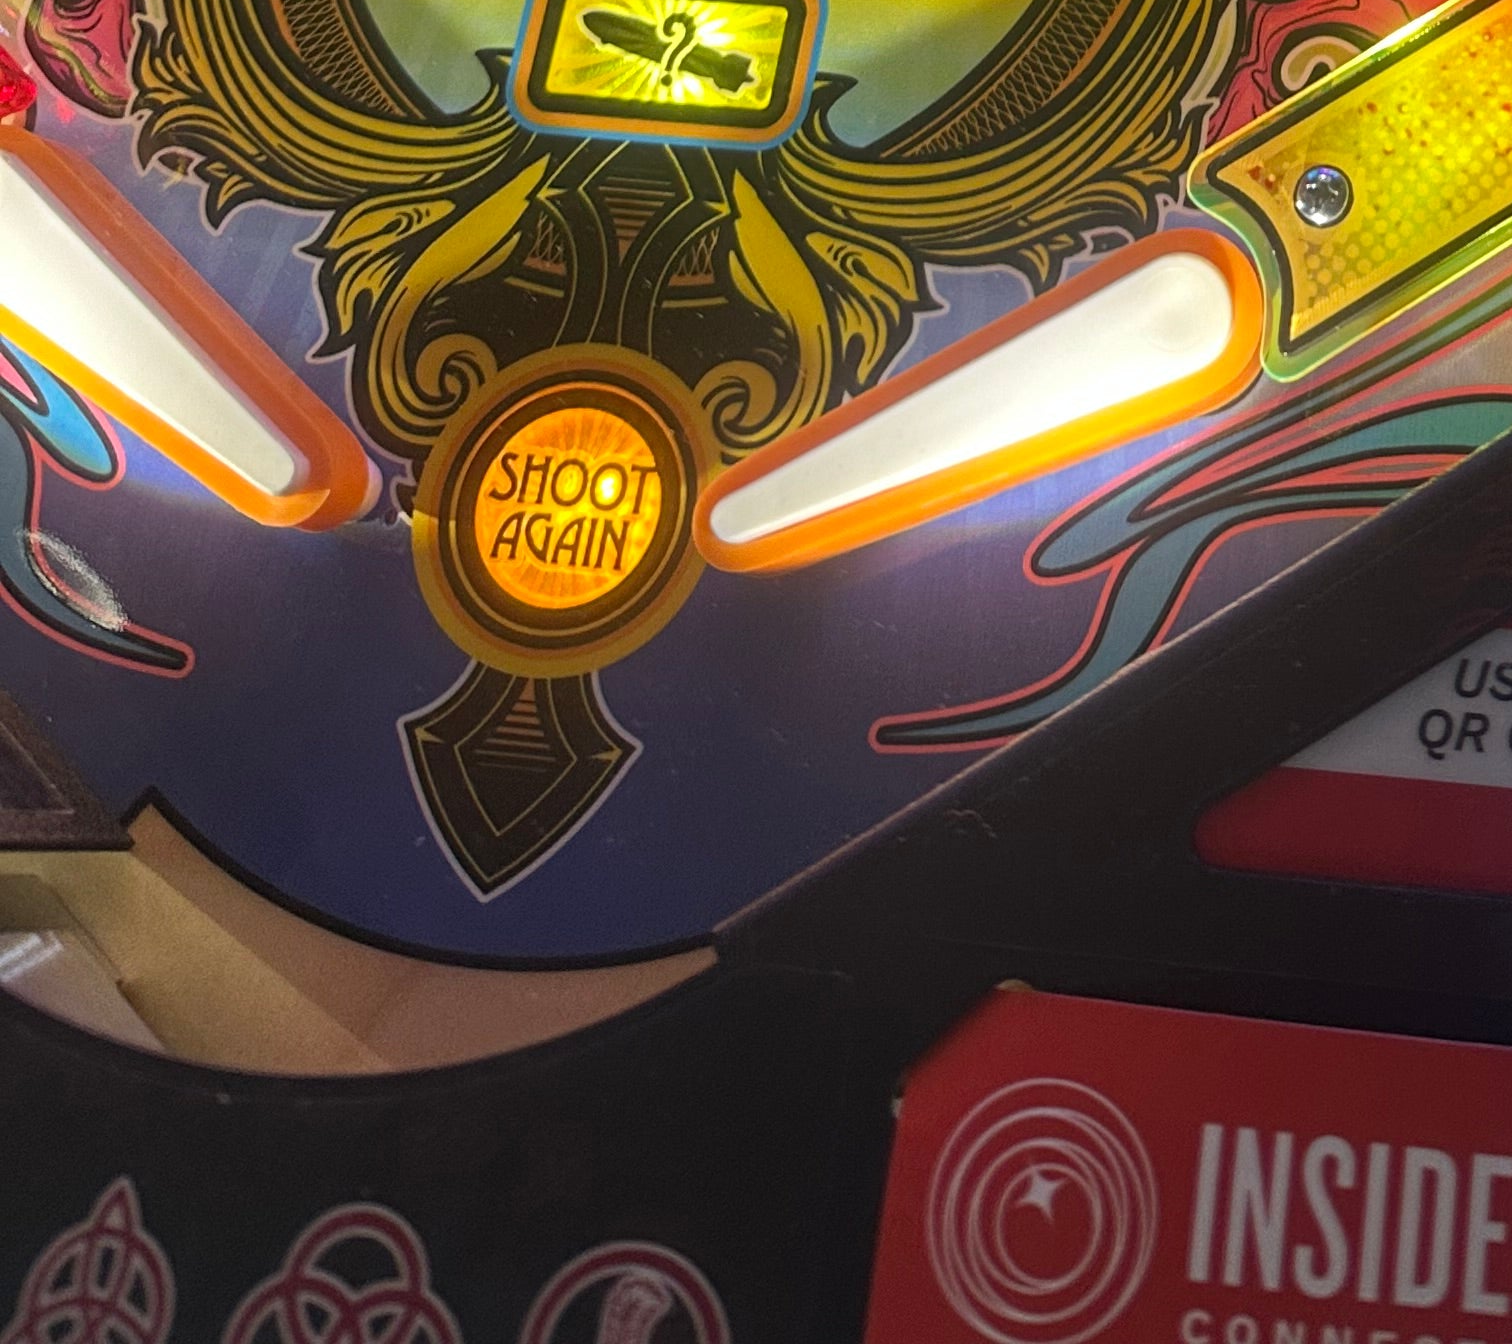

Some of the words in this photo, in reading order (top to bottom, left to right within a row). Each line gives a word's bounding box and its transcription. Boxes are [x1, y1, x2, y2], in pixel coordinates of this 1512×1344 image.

[488, 451, 659, 515] SHOOT
[489, 511, 631, 572] AGAIN
[1418, 708, 1490, 761] QR
